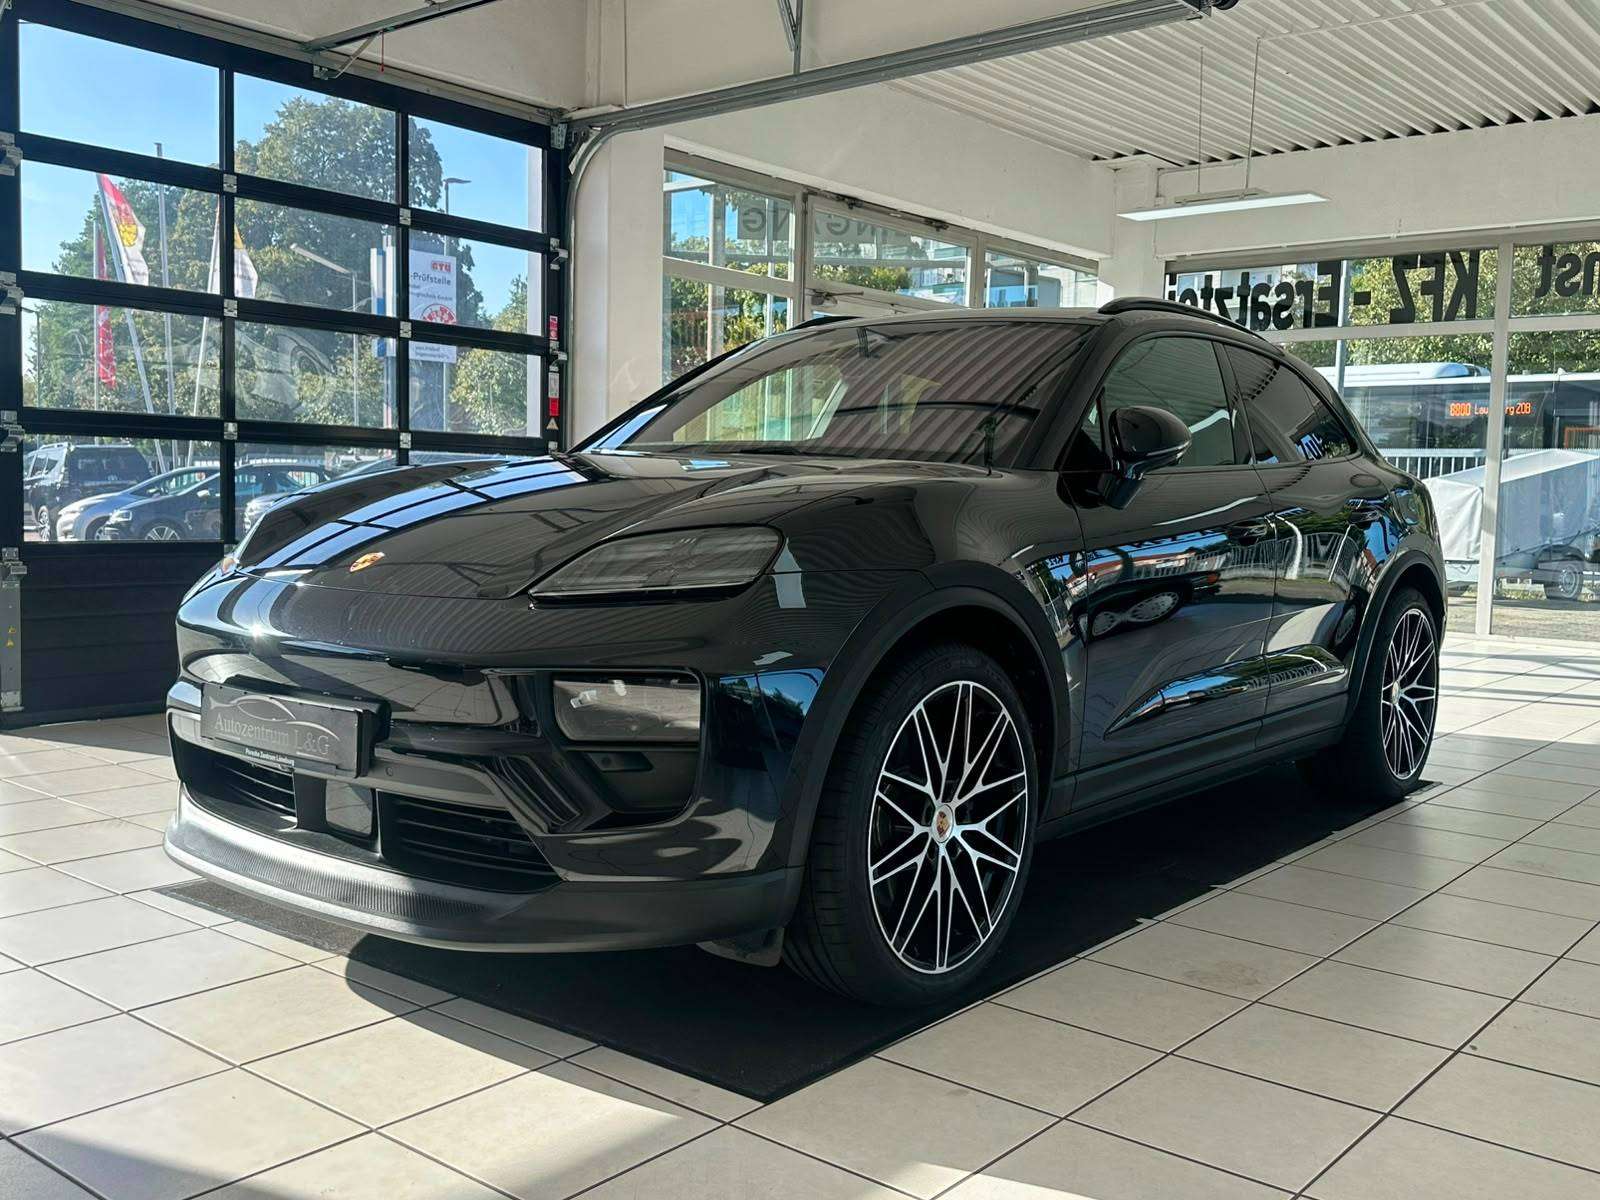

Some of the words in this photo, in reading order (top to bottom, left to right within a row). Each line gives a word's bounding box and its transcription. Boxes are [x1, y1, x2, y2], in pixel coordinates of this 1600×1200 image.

[1474, 403, 1515, 415] Laurg
[214, 713, 289, 746] Autozentrum
[294, 728, 331, 756] L&G
